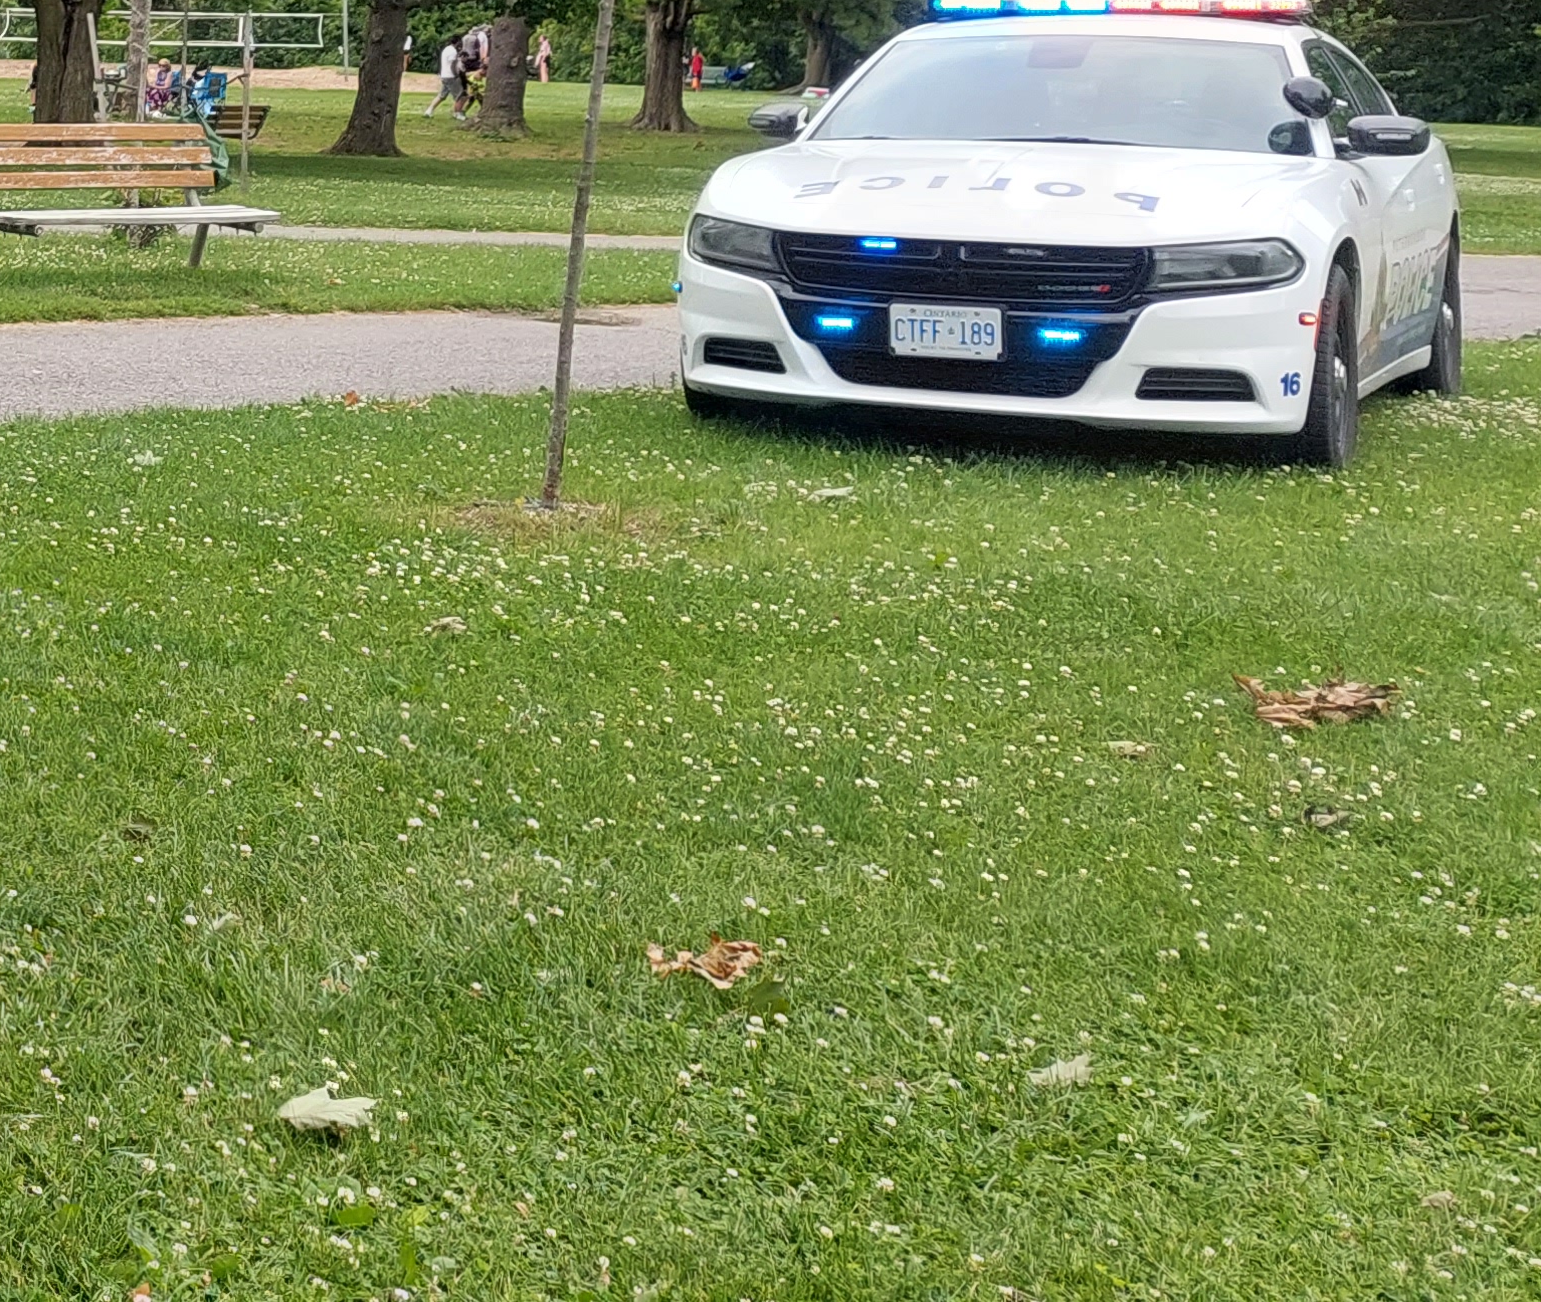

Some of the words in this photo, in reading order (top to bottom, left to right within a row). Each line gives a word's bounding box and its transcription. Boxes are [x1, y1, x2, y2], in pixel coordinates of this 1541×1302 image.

[923, 309, 968, 318] ONTARIO
[894, 317, 945, 344] CTFF
[959, 320, 996, 347] 189
[1280, 371, 1302, 397] 16
